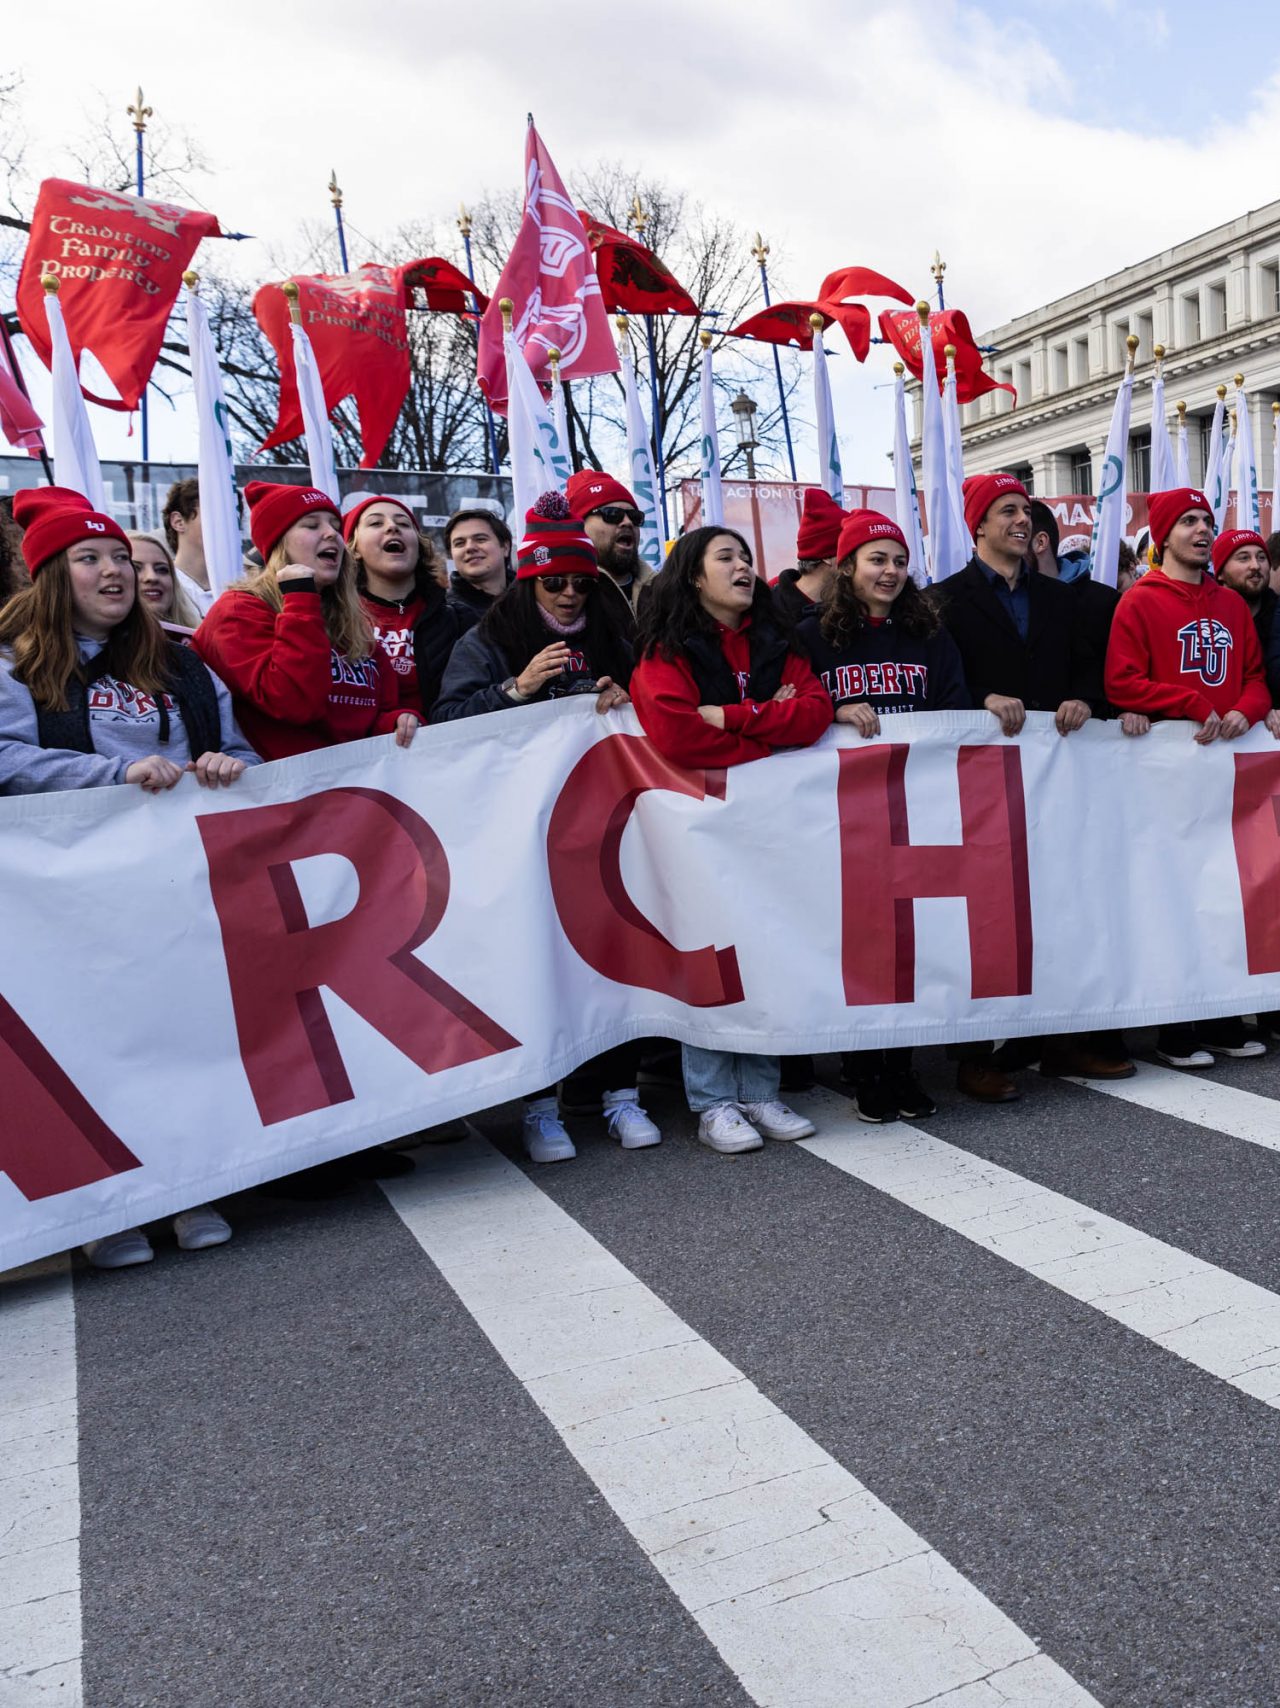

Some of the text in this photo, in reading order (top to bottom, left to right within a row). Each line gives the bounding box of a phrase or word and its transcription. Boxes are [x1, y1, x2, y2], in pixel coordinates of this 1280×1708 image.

[726, 487, 783, 500] ACTION
[85, 520, 105, 531] LU
[821, 662, 929, 701] LIBERTY
